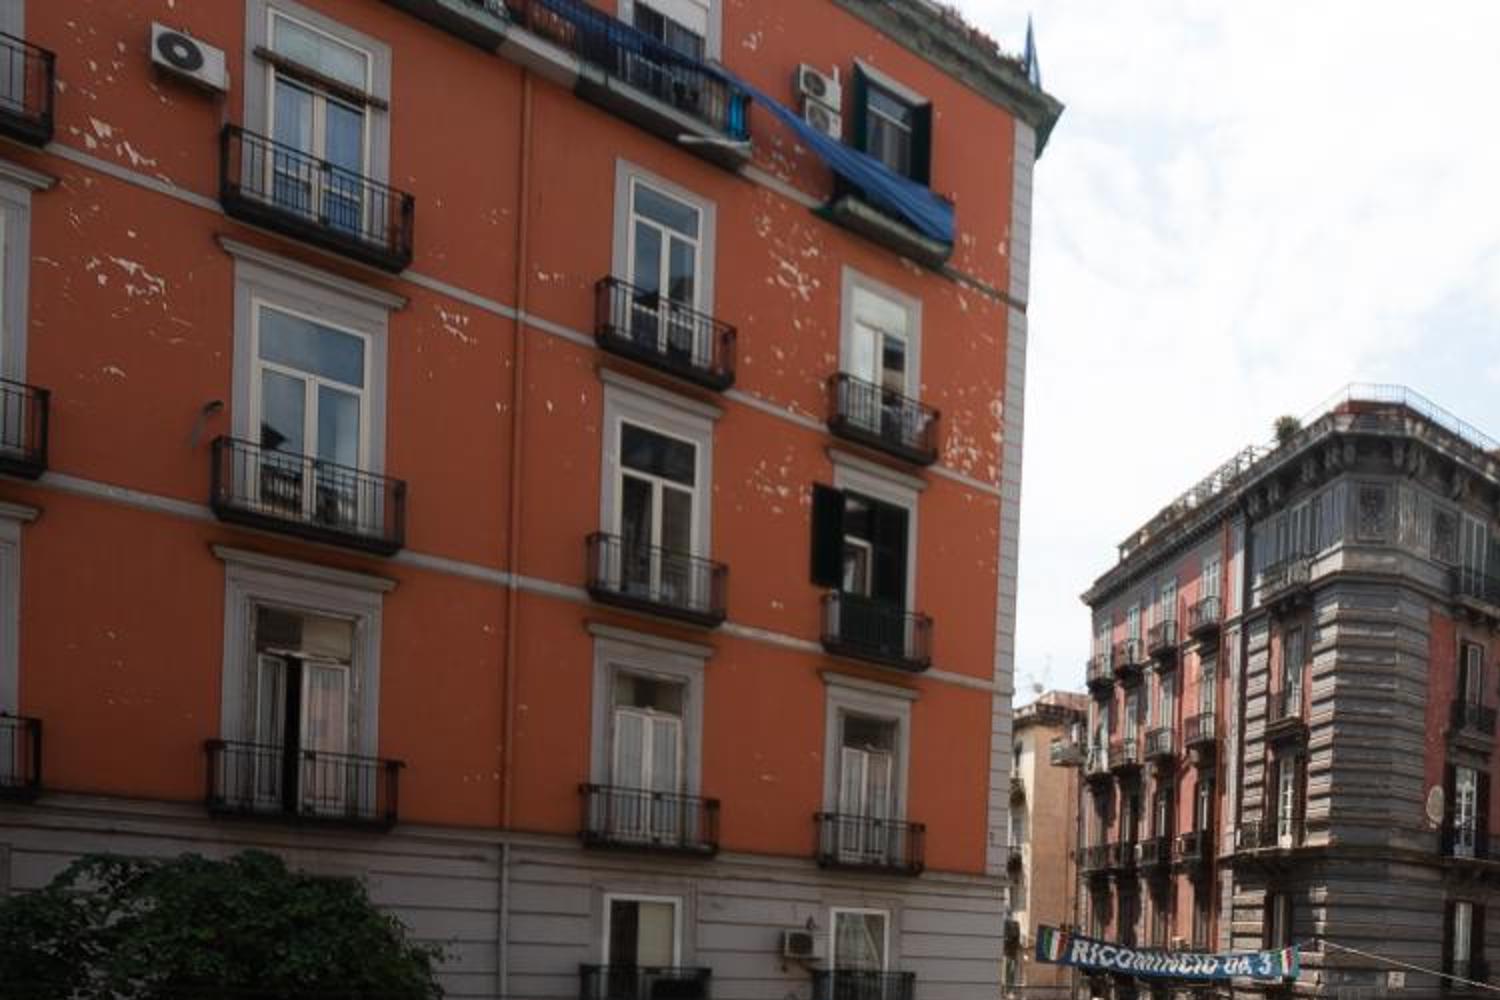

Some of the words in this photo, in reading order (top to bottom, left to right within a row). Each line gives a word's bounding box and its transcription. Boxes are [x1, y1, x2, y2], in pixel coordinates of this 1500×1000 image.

[1071, 939, 1218, 974] RICOMINCIO
[1223, 957, 1253, 975] DA
[1258, 952, 1273, 975] 3
